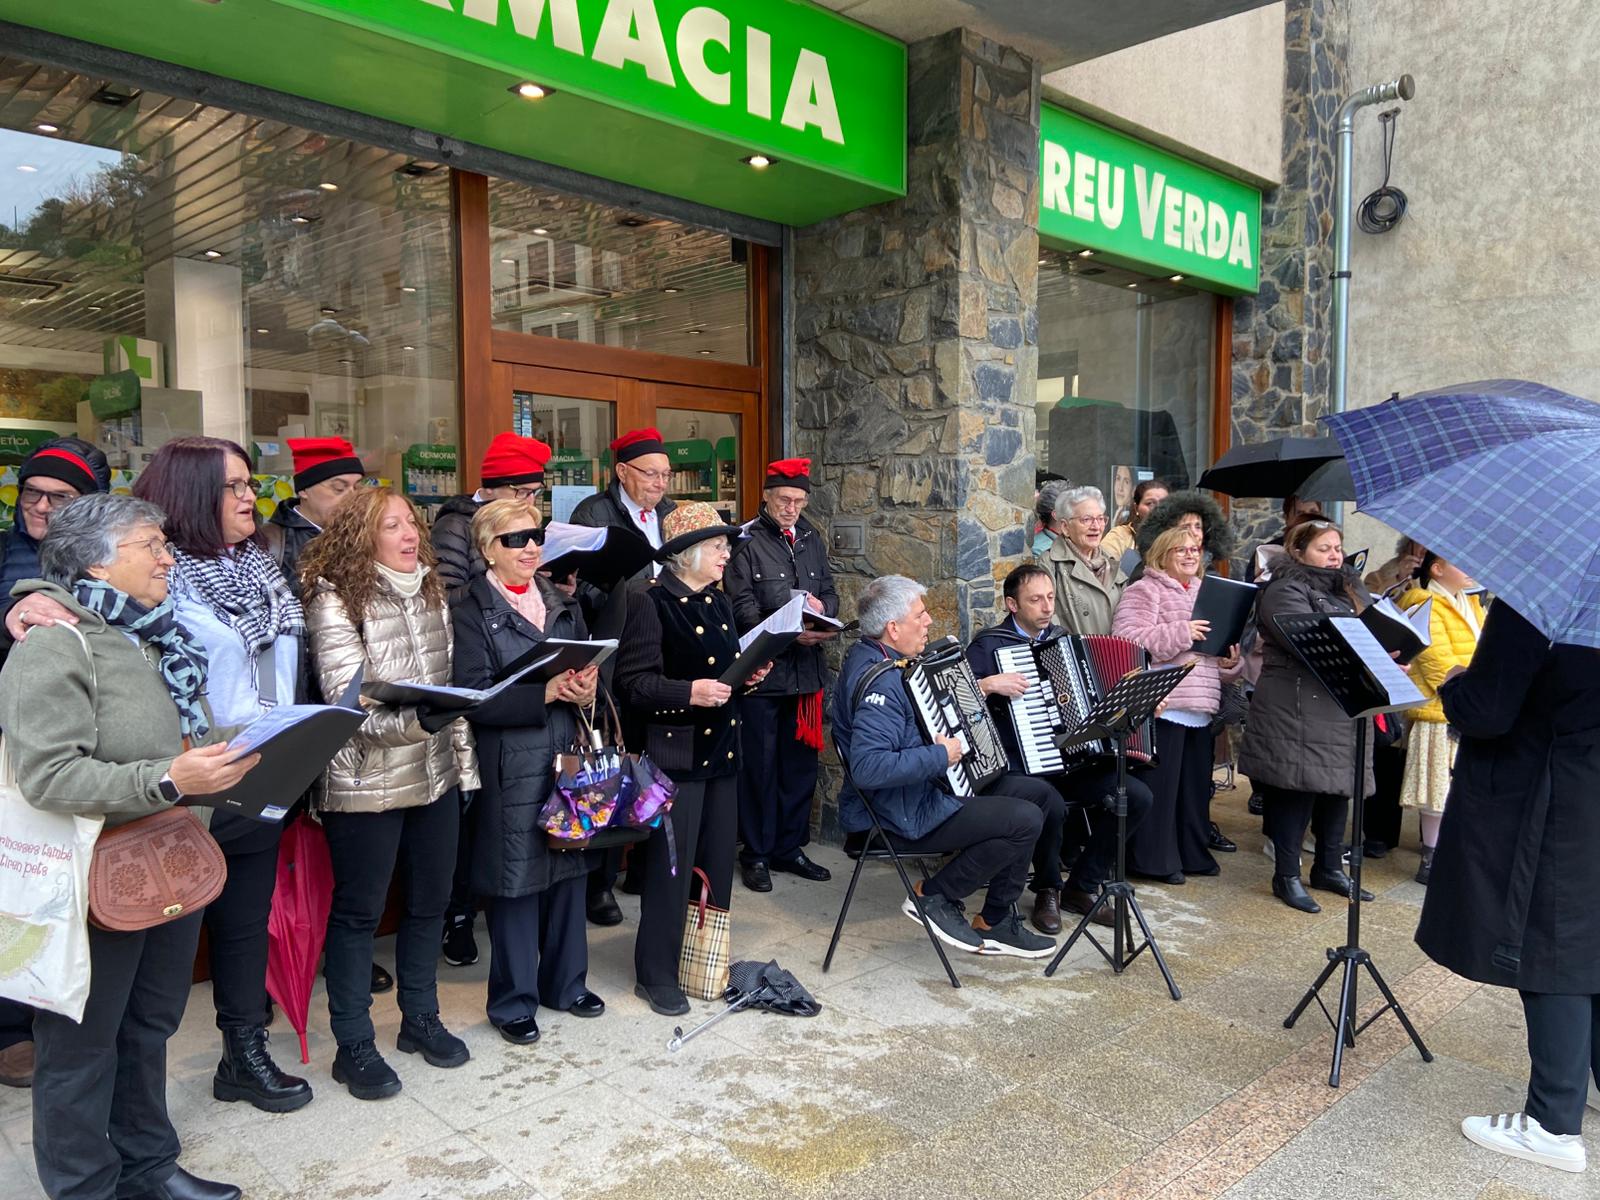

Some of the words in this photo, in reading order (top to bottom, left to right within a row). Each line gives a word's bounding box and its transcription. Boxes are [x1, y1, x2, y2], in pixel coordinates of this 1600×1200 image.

[420, 0, 845, 145] ACIA
[1043, 139, 1125, 230] REU
[1133, 163, 1253, 269] VERDA
[22, 861, 49, 878] pets
